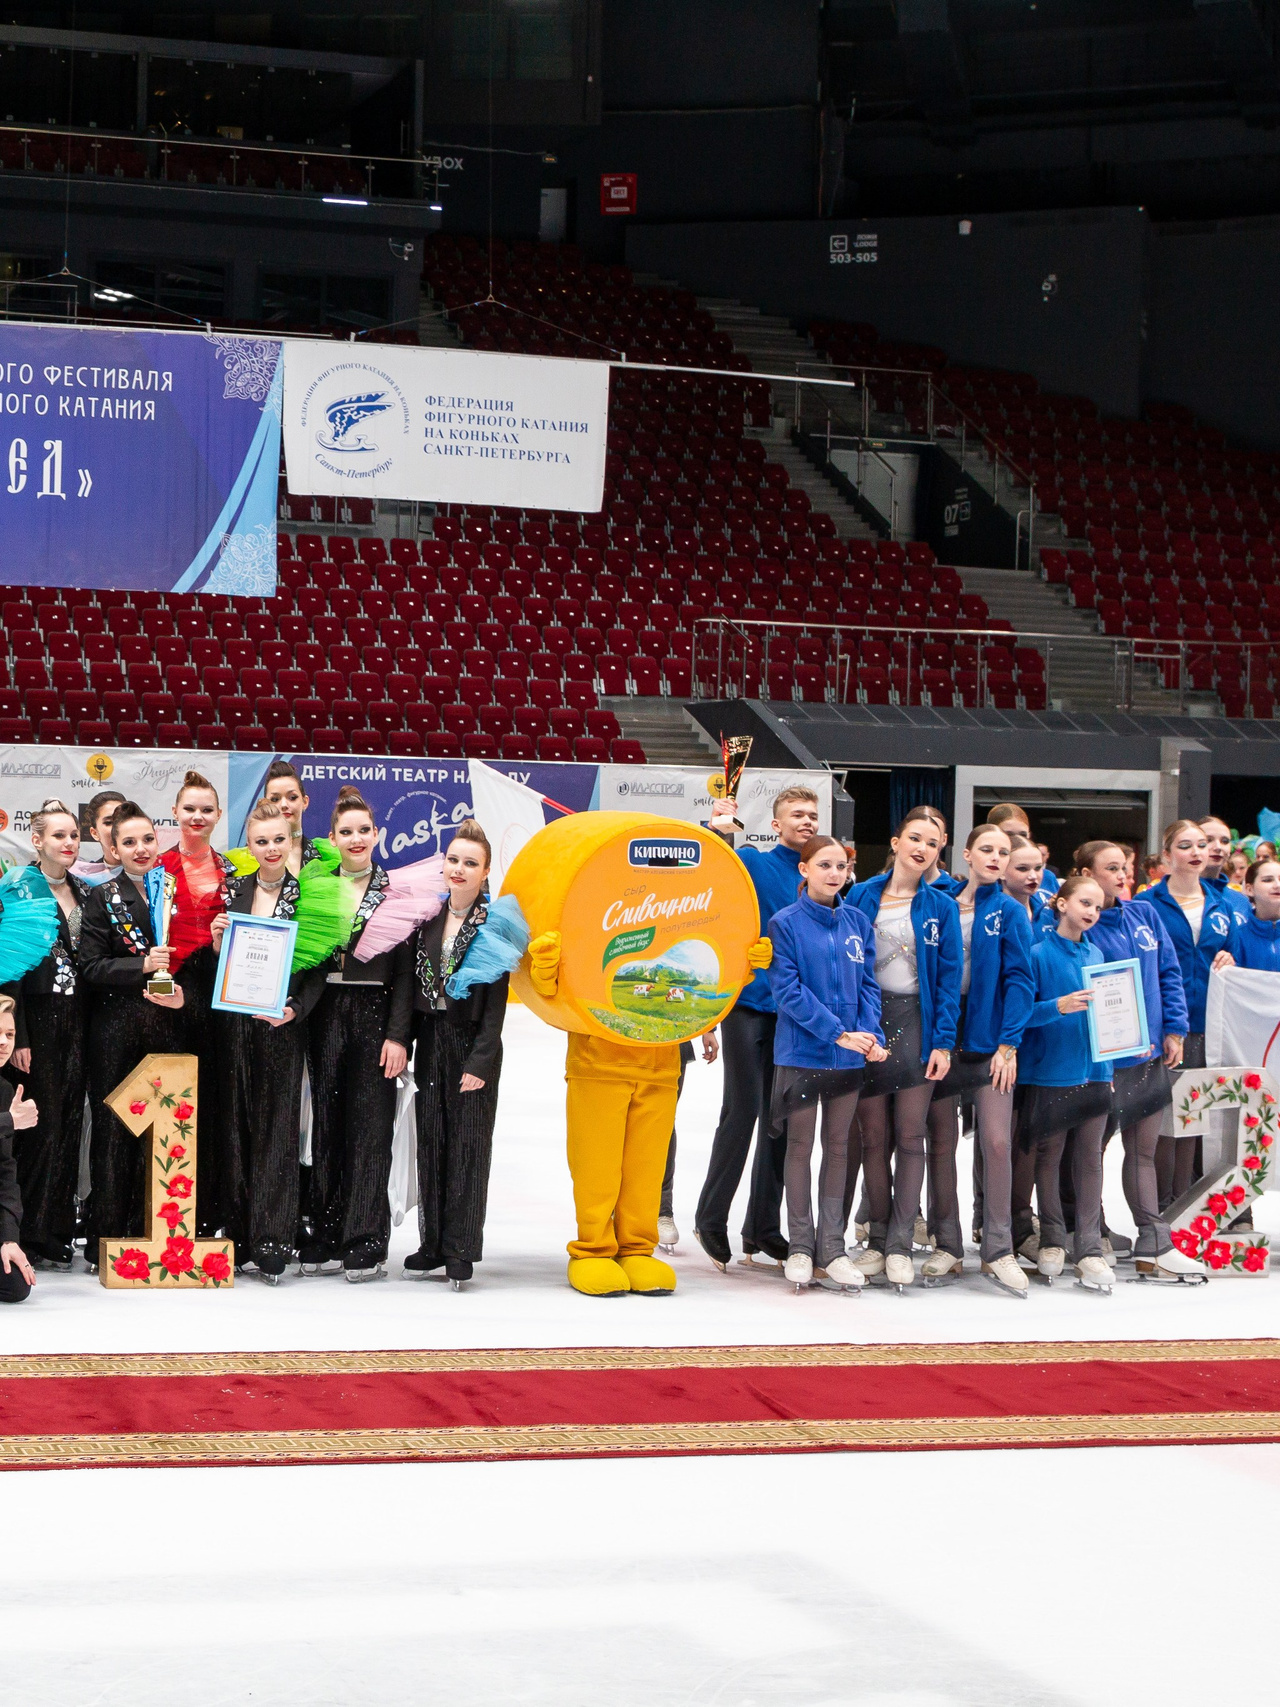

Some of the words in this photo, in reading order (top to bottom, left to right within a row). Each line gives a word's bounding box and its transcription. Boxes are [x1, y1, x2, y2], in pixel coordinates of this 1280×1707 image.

[830, 252, 878, 264] 503-505
[43, 365, 173, 392] ФЕСТИВАЛЯ
[59, 396, 156, 421] КАТАНИЯ
[424, 395, 514, 412] ФЕДЕРАЦИЯ
[424, 411, 517, 428] ФИГУРНОГО
[521, 418, 589, 434] КАТАНИЯ
[424, 427, 445, 440] НА
[449, 429, 520, 444] КОНЬКАХ
[423, 443, 572, 465] САНКТ-ПЕТЕРБУРГА
[315, 453, 393, 478] Санкт-Петербург
[71, 778, 95, 788] smile
[300, 764, 386, 781] ДЕТСКИЙ
[392, 767, 448, 783] ТЕАТР
[634, 846, 696, 859] КИПРИНО
[623, 884, 647, 897] сыр
[602, 887, 713, 931] Сливочный
